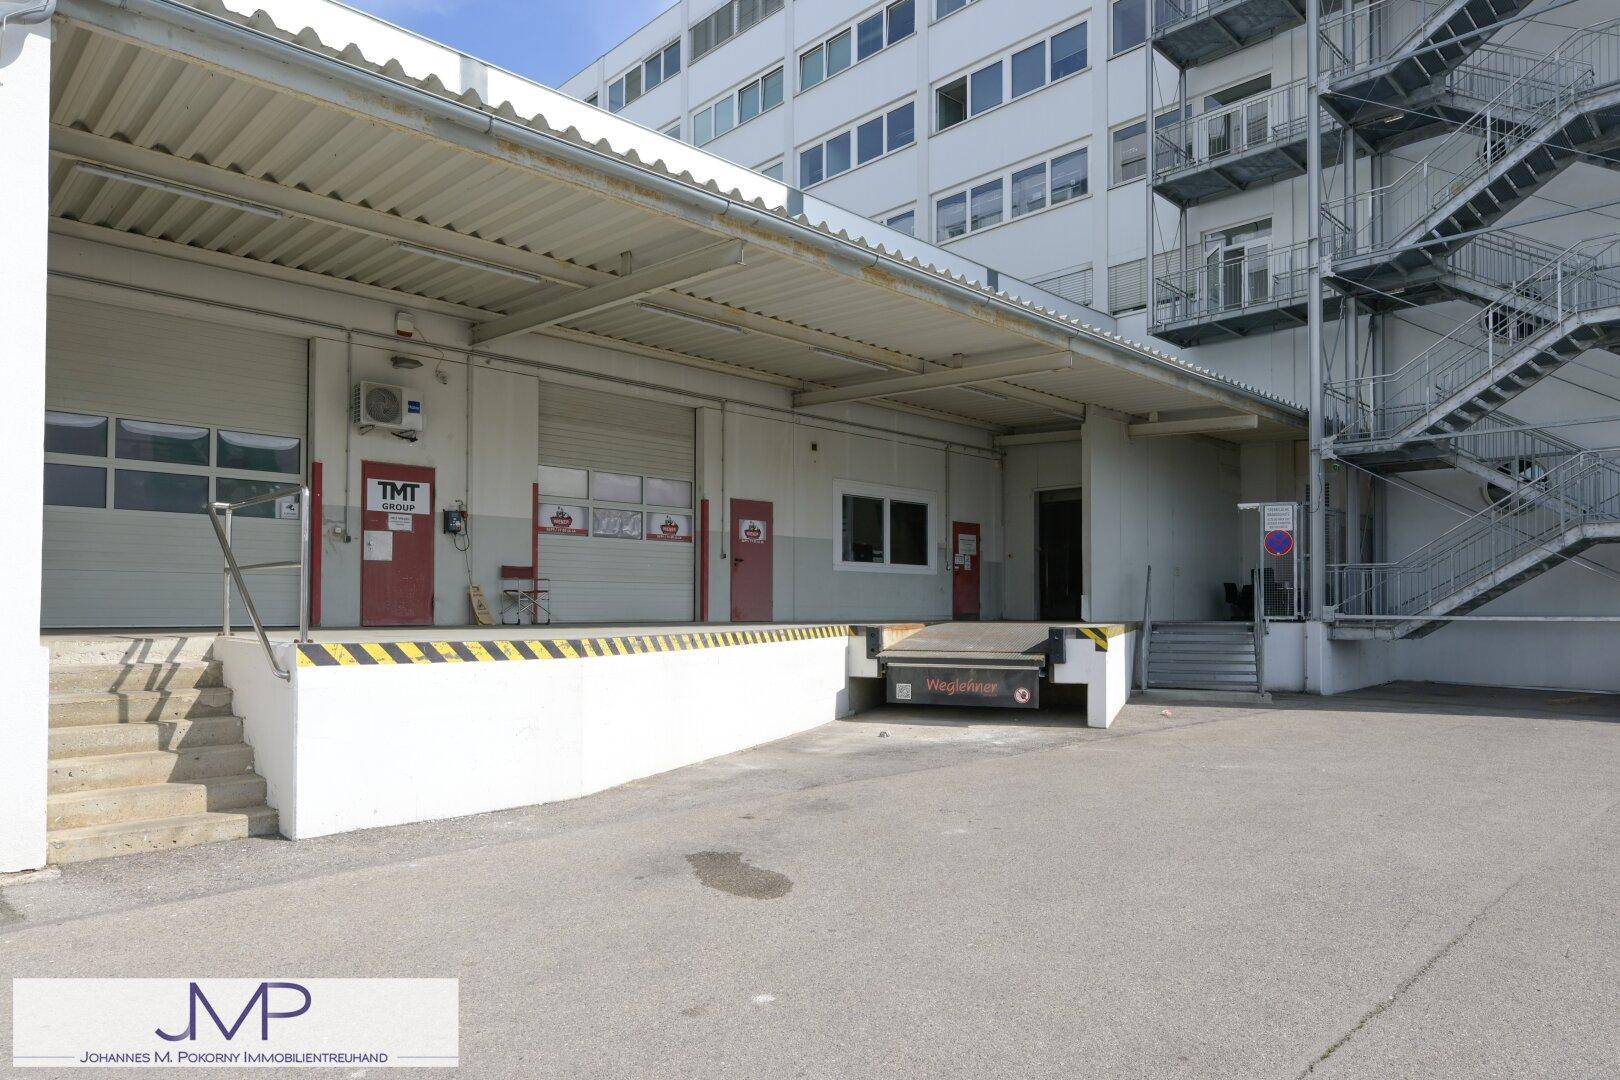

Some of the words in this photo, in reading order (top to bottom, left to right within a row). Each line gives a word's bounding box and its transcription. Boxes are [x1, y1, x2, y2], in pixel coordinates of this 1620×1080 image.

[378, 481, 420, 502] TMT
[381, 503, 416, 512] GROUP
[926, 678, 998, 696] Weglehner
